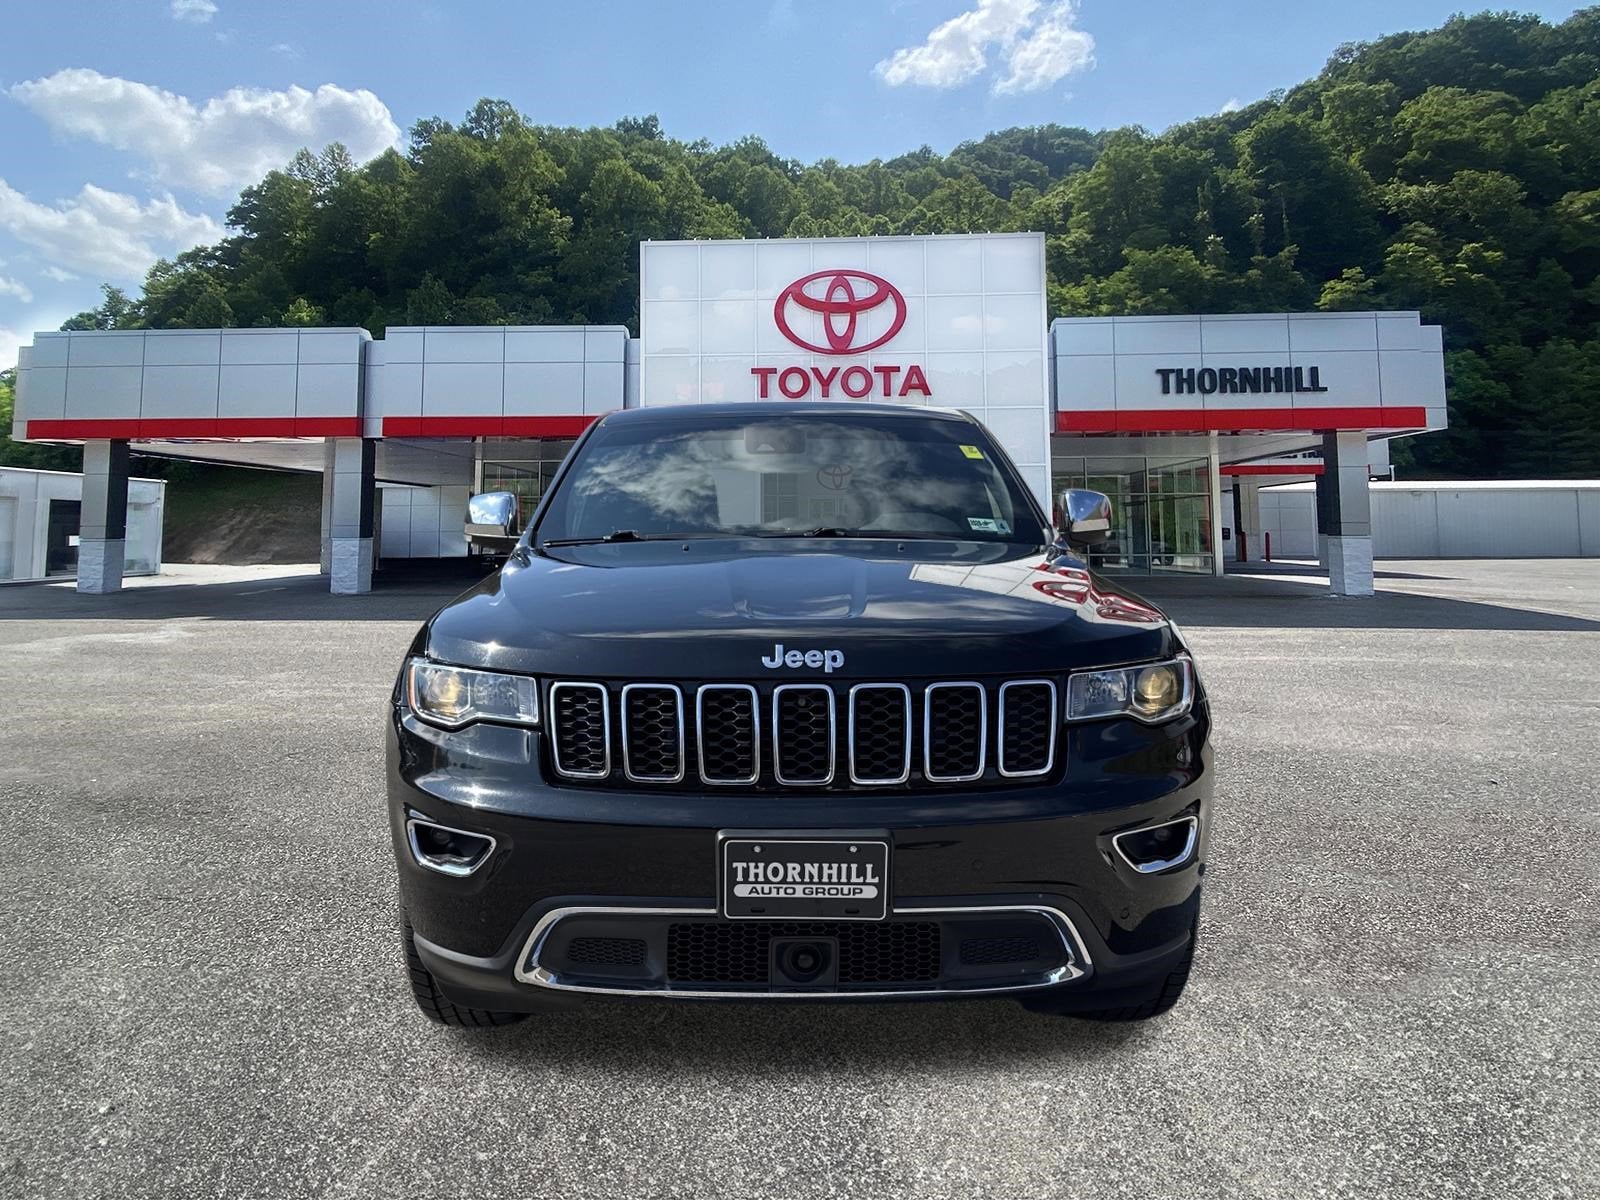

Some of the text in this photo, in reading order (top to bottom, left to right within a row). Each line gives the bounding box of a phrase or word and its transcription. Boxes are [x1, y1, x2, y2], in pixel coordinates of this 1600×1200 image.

[751, 366, 932, 398] TOYOTA
[1155, 366, 1328, 394] THORNHILL
[761, 644, 845, 673] Jeep
[732, 862, 879, 883] THORNHILL
[748, 886, 864, 897] AUTO GROUP
